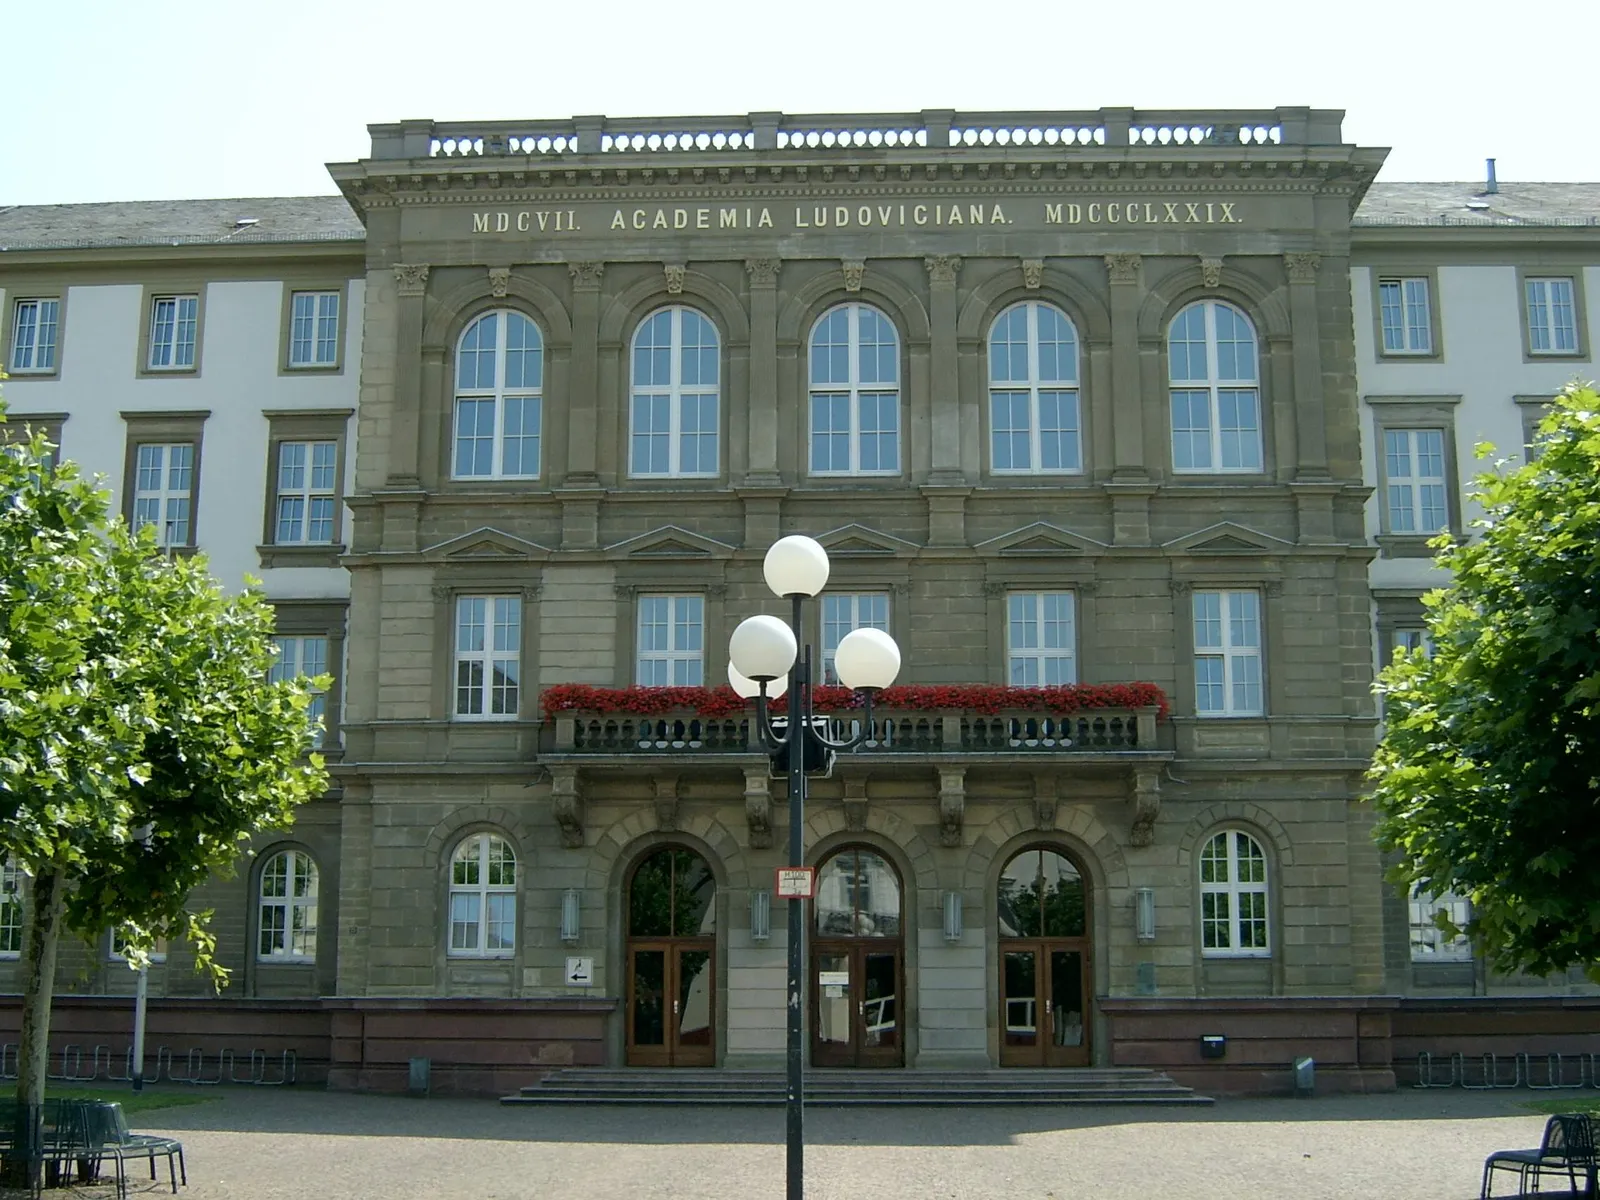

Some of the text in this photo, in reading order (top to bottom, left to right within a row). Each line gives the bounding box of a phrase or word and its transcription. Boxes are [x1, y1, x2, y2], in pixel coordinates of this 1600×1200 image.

[472, 202, 1243, 233] MDCVII. ACADEMIA LUDOVICIANA. MDCCCLXXIX.
